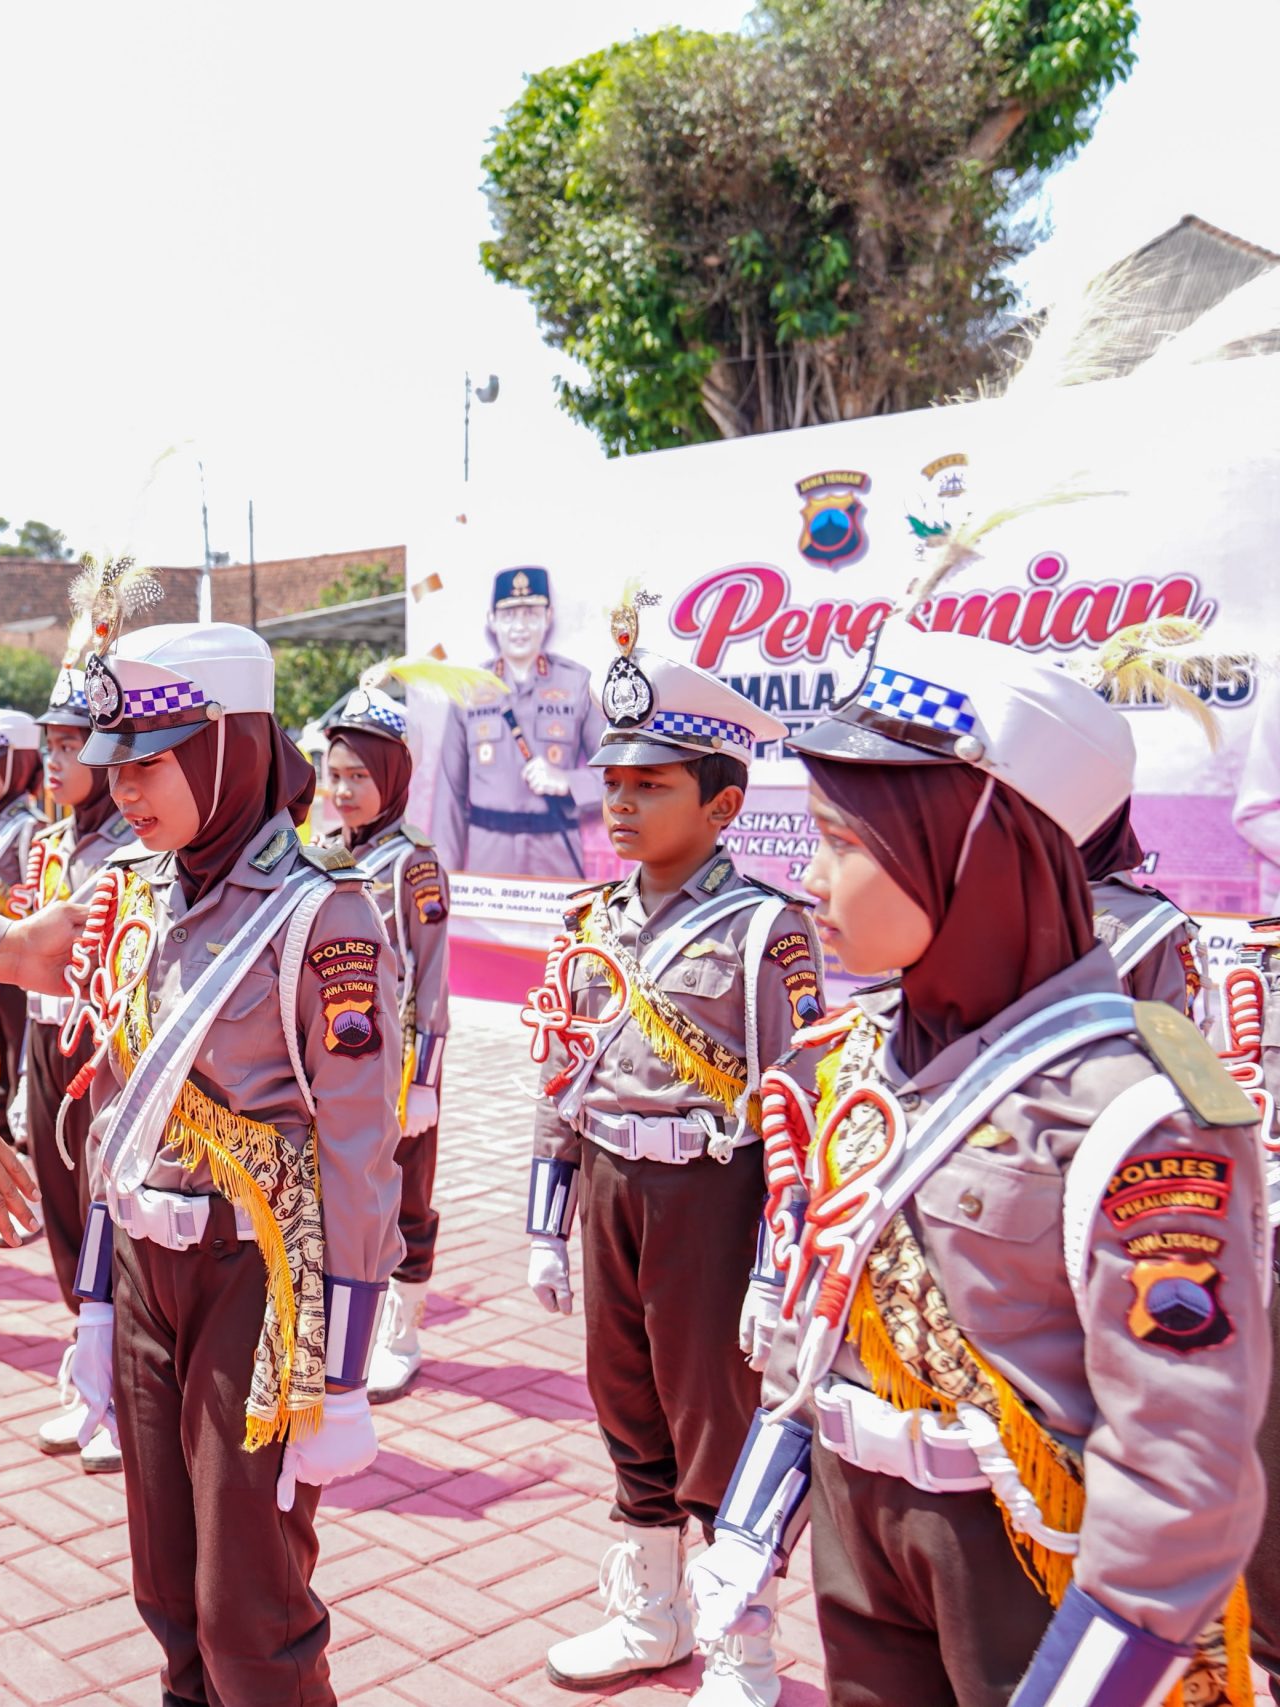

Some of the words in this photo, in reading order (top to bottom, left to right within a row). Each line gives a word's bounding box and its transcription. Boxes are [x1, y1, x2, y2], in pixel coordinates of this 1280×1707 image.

[720, 673, 837, 712] MALA
[312, 942, 374, 963] POLRES
[770, 935, 807, 957] POLRES
[321, 961, 374, 979] PEKALONGAN
[322, 984, 343, 999] JAWA
[344, 981, 374, 993] TENGAH
[1107, 1158, 1218, 1194] POLRES
[1115, 1191, 1219, 1220] PEKALONGAN
